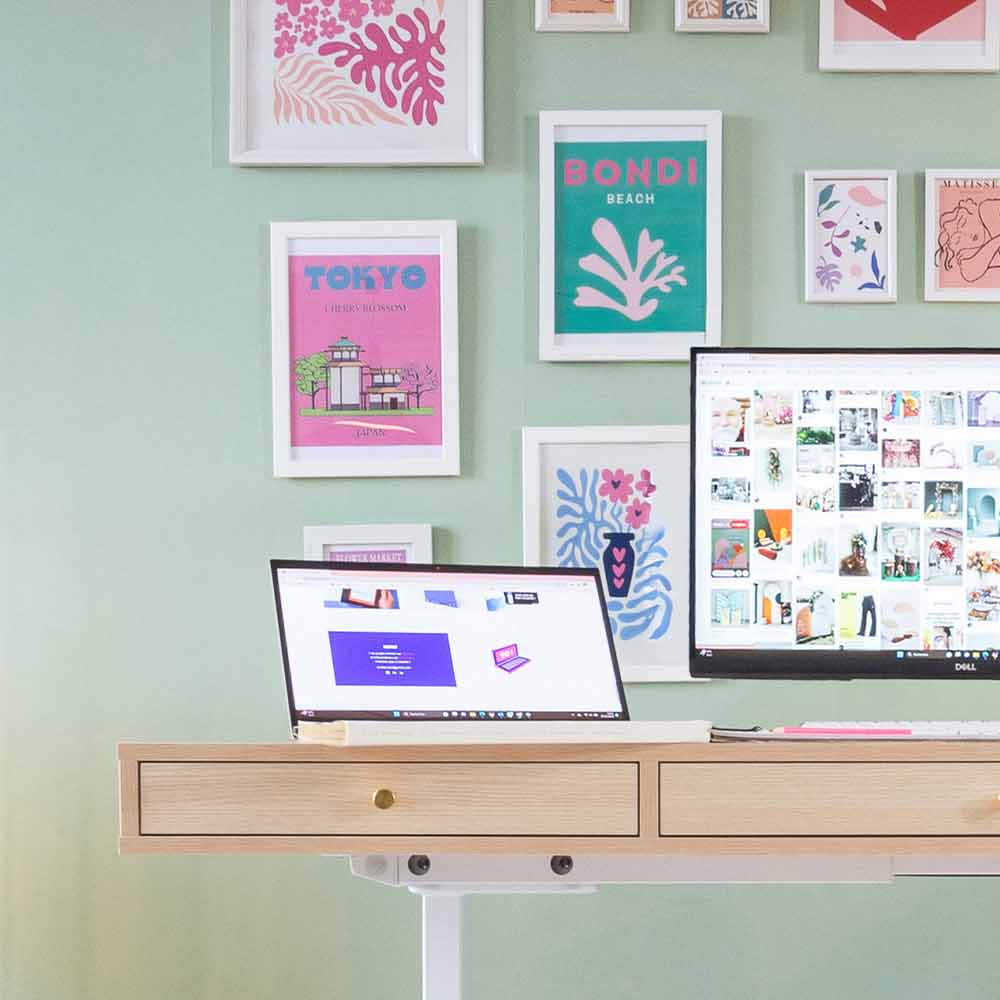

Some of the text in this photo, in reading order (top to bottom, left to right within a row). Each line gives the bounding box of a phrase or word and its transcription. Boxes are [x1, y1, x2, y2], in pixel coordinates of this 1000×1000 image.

[564, 158, 698, 187] BONDI
[943, 179, 1000, 188] MATISSE
[606, 193, 655, 204] BEACH
[303, 264, 427, 290] TOKYO
[323, 303, 408, 313] CHERRY BLOSSOM
[353, 427, 386, 439] JAPAN
[954, 662, 977, 671] DELL
